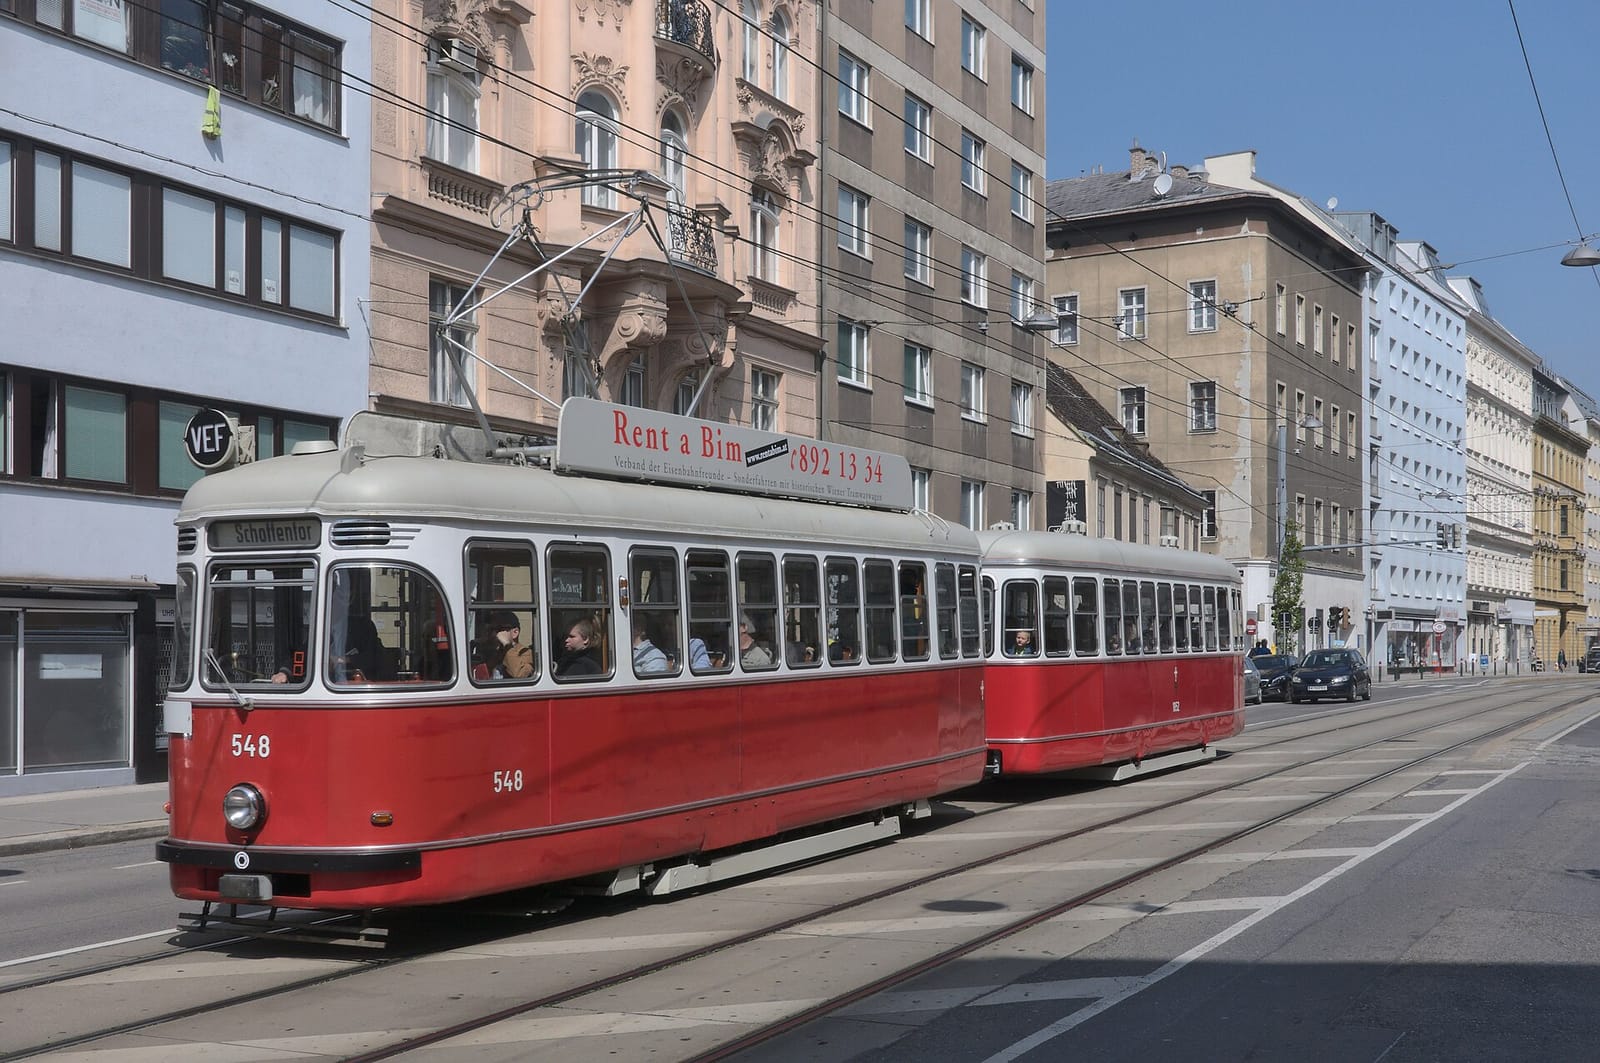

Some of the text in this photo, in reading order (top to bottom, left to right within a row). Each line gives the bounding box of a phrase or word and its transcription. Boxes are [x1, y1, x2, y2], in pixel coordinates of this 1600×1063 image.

[190, 423, 226, 454] VEF
[613, 410, 742, 462] Rent a Bim
[614, 456, 646, 471] Verband
[648, 461, 660, 473] der
[663, 463, 725, 481] Eisenbahnfreunde
[799, 444, 883, 483] 892 13 34
[235, 522, 312, 543] Schottentor
[231, 733, 270, 758] 548
[493, 769, 523, 793] 548
